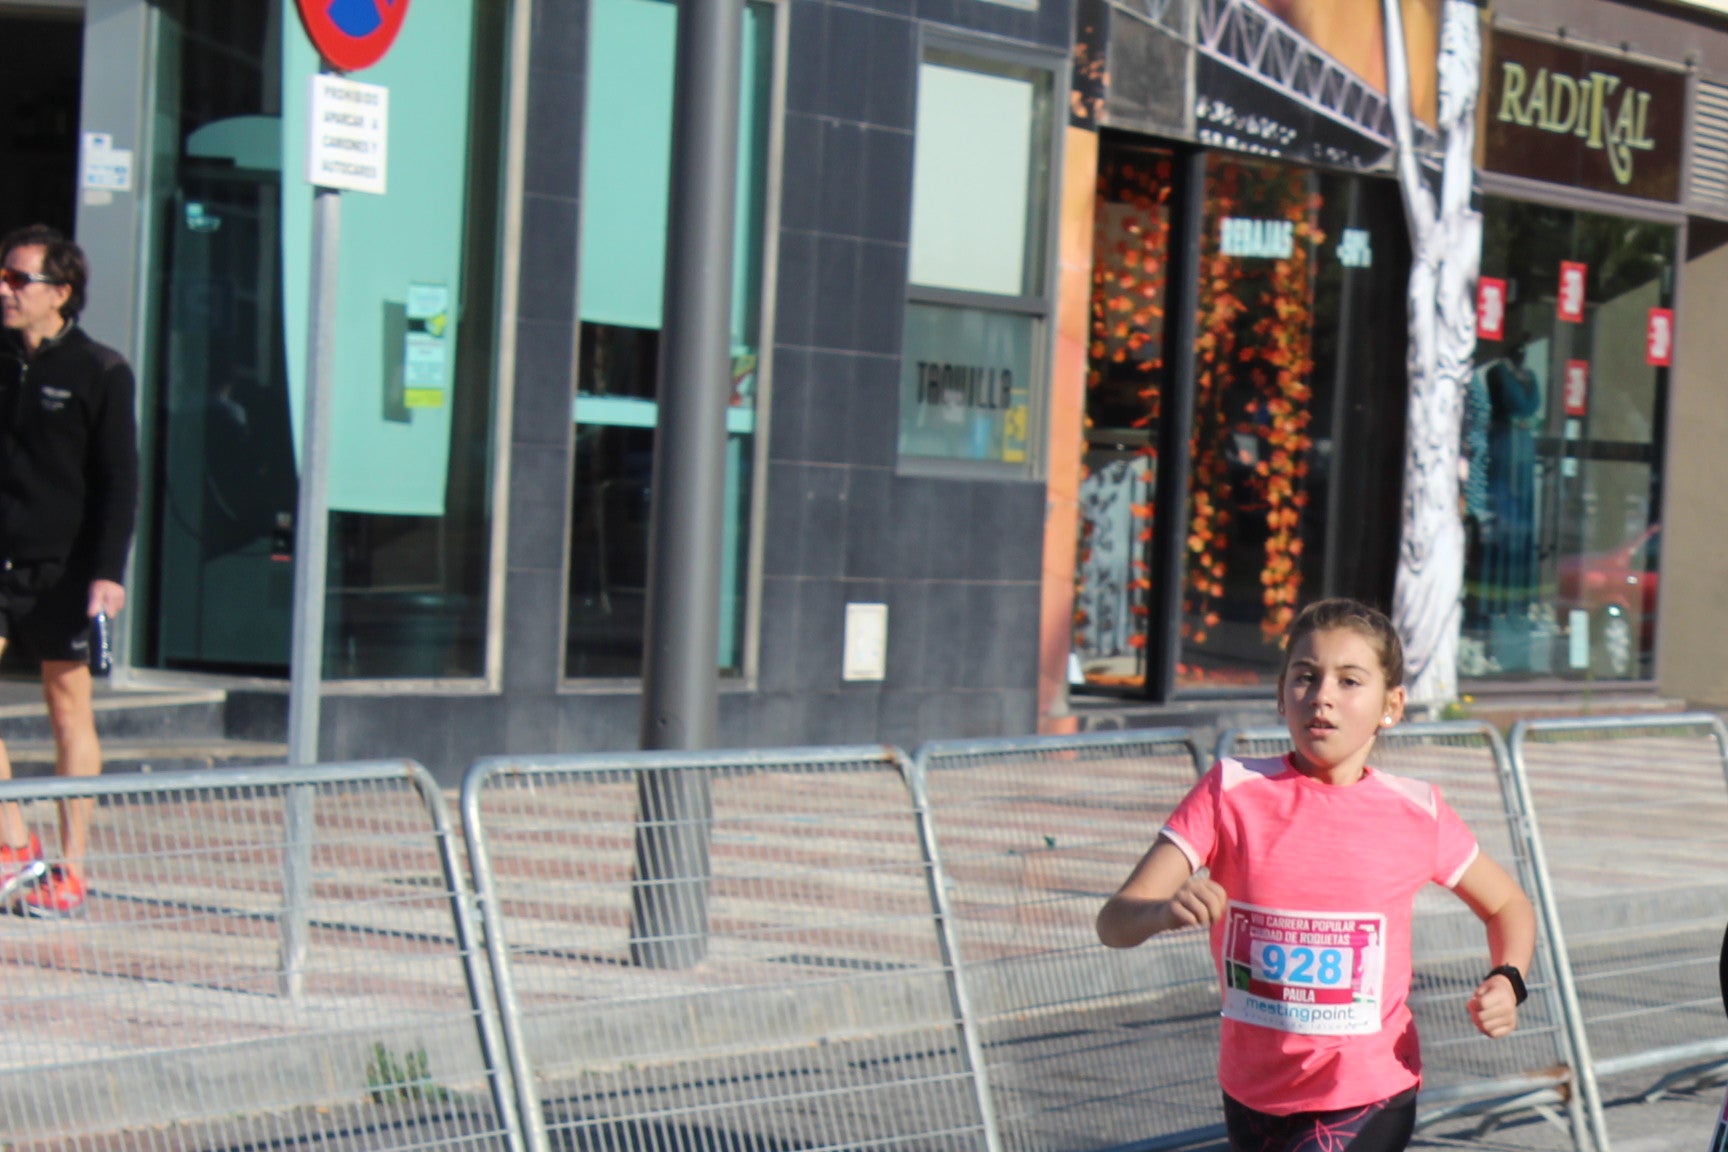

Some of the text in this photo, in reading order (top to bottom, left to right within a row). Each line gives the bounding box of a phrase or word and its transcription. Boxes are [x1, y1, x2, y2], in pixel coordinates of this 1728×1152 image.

[1497, 61, 1655, 185] RADIKAL
[1266, 916, 1310, 931] CARRERA
[1311, 919, 1356, 932] POPULAR
[1284, 932, 1298, 943] DE
[1299, 932, 1351, 946] ROQUETAS
[1261, 944, 1343, 985] 928
[1282, 987, 1316, 1003] PAULA
